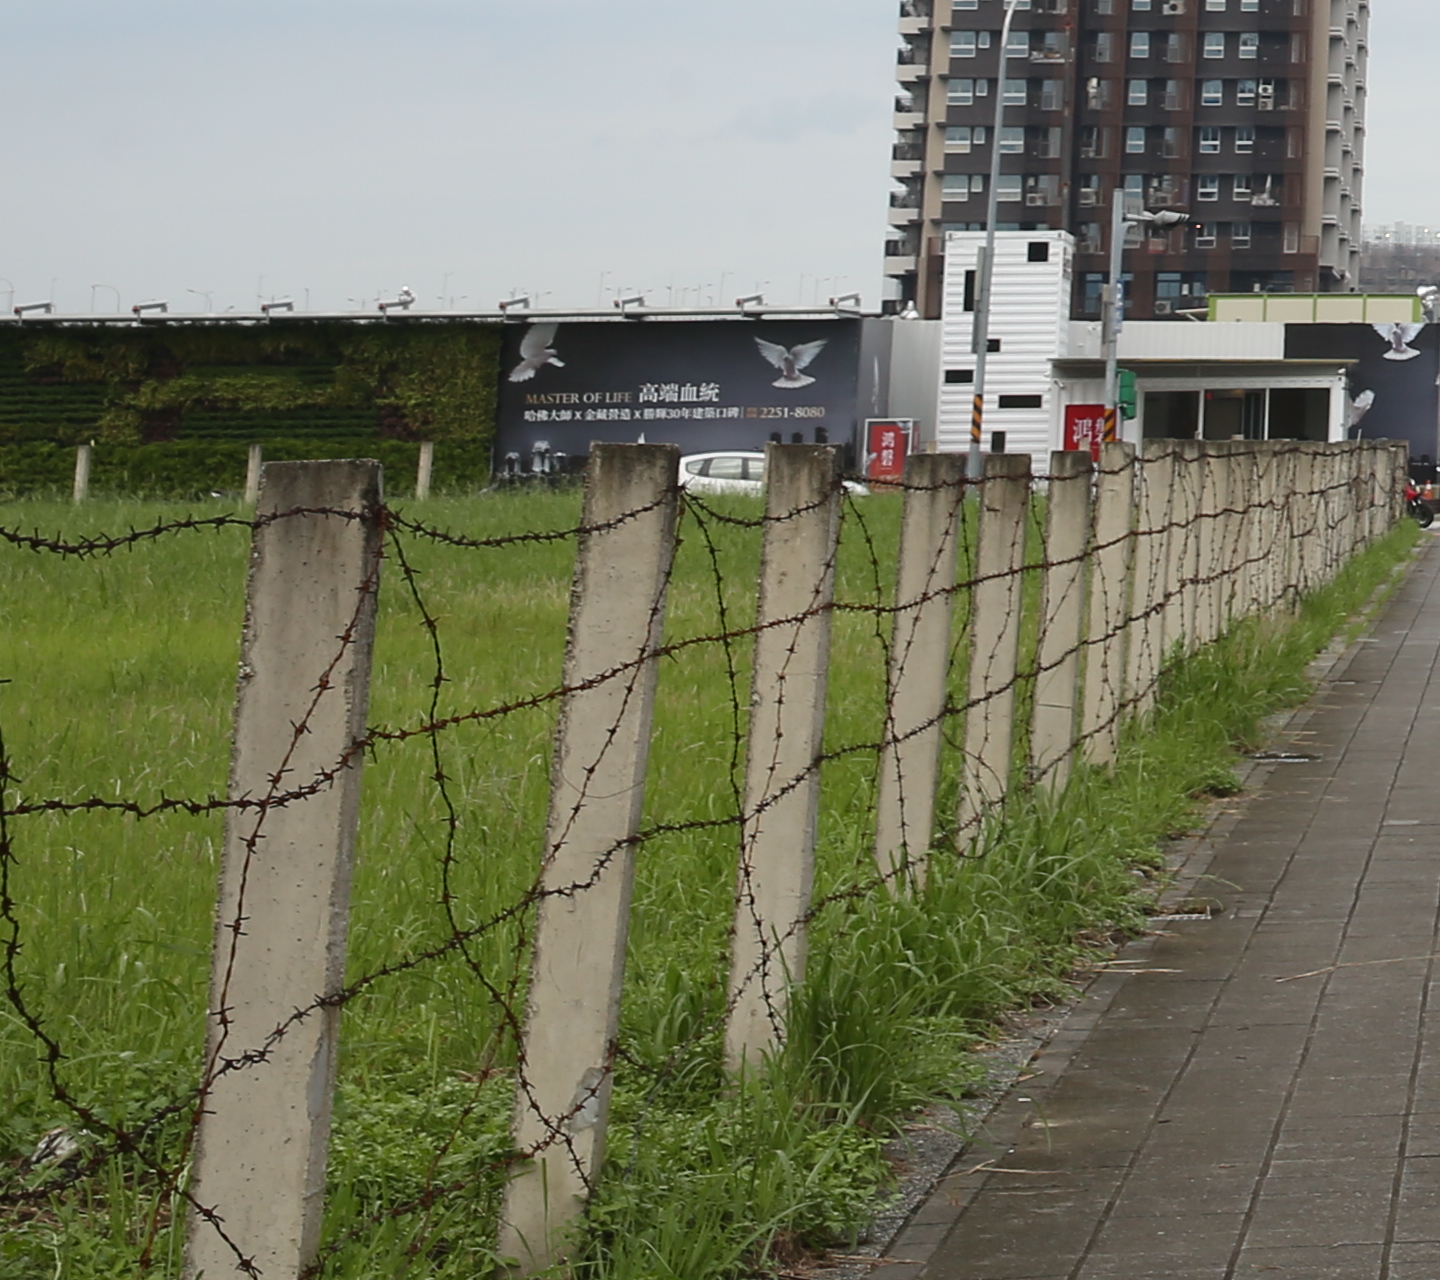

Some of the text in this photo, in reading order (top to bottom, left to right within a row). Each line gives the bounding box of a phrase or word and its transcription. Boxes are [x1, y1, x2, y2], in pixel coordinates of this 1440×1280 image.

[525, 393, 580, 405] MASTER
[583, 392, 603, 404] OF
[605, 392, 632, 404] LIFE
[759, 406, 826, 419] 2251-8080
